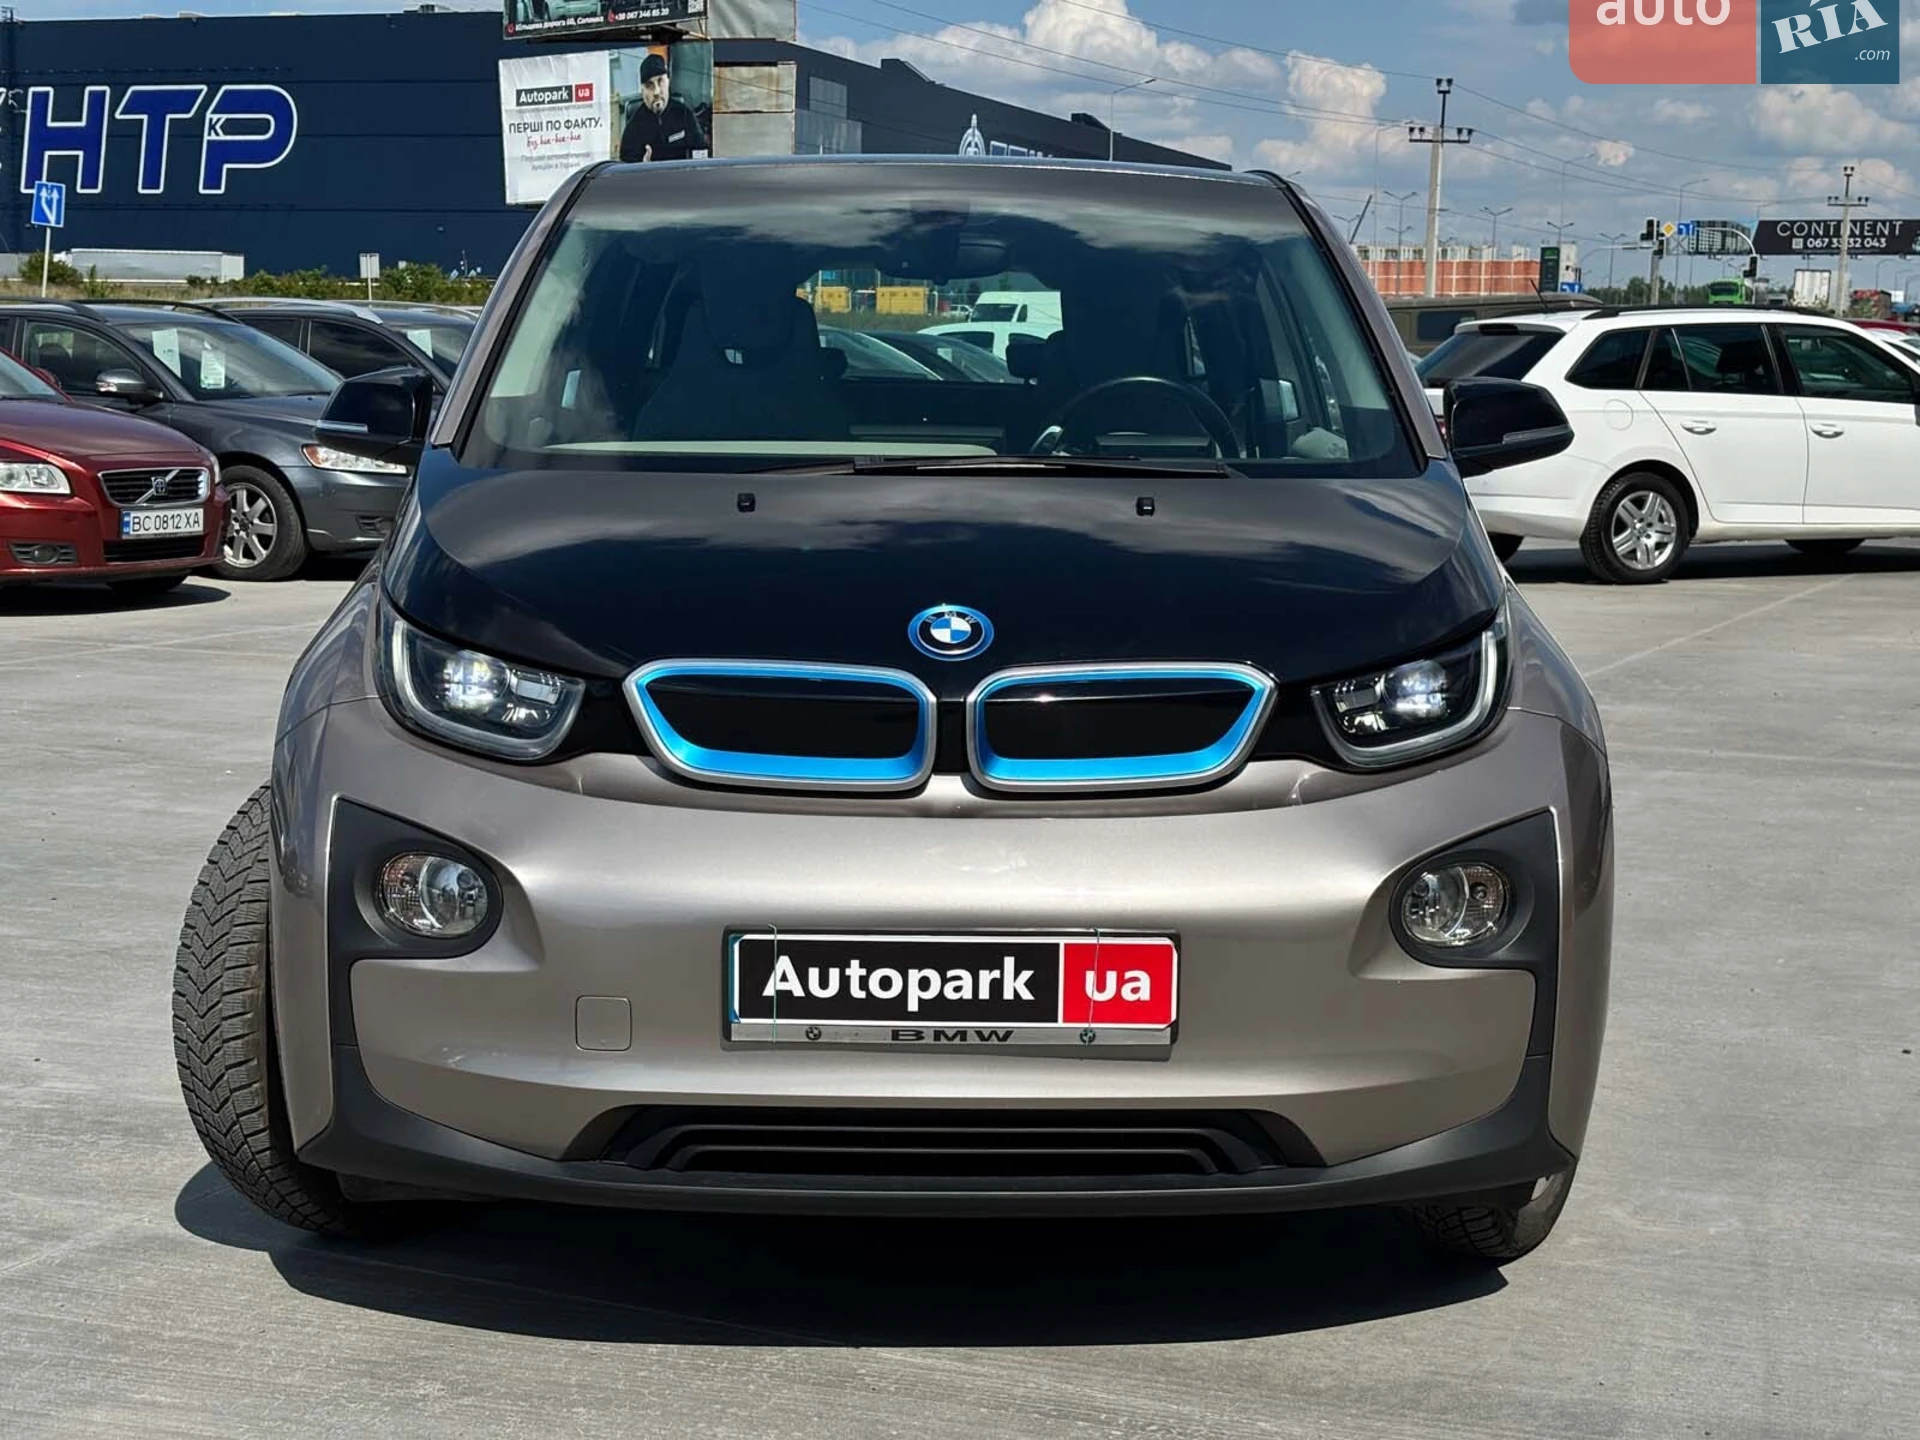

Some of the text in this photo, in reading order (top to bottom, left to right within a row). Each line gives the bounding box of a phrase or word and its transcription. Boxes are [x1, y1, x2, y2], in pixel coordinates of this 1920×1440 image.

[519, 86, 590, 104] Autopark ua
[509, 117, 603, 134] ПЕРШІ ПО ФАКТУ.
[0, 84, 298, 195] НТР
[1776, 221, 1904, 237] CONTINENT
[1807, 238, 1829, 248] 067
[1864, 238, 1887, 248] 043
[132, 511, 201, 532] BC 0812 XA
[762, 955, 1152, 1012] Autopark ua
[890, 1028, 1015, 1043] BMW
